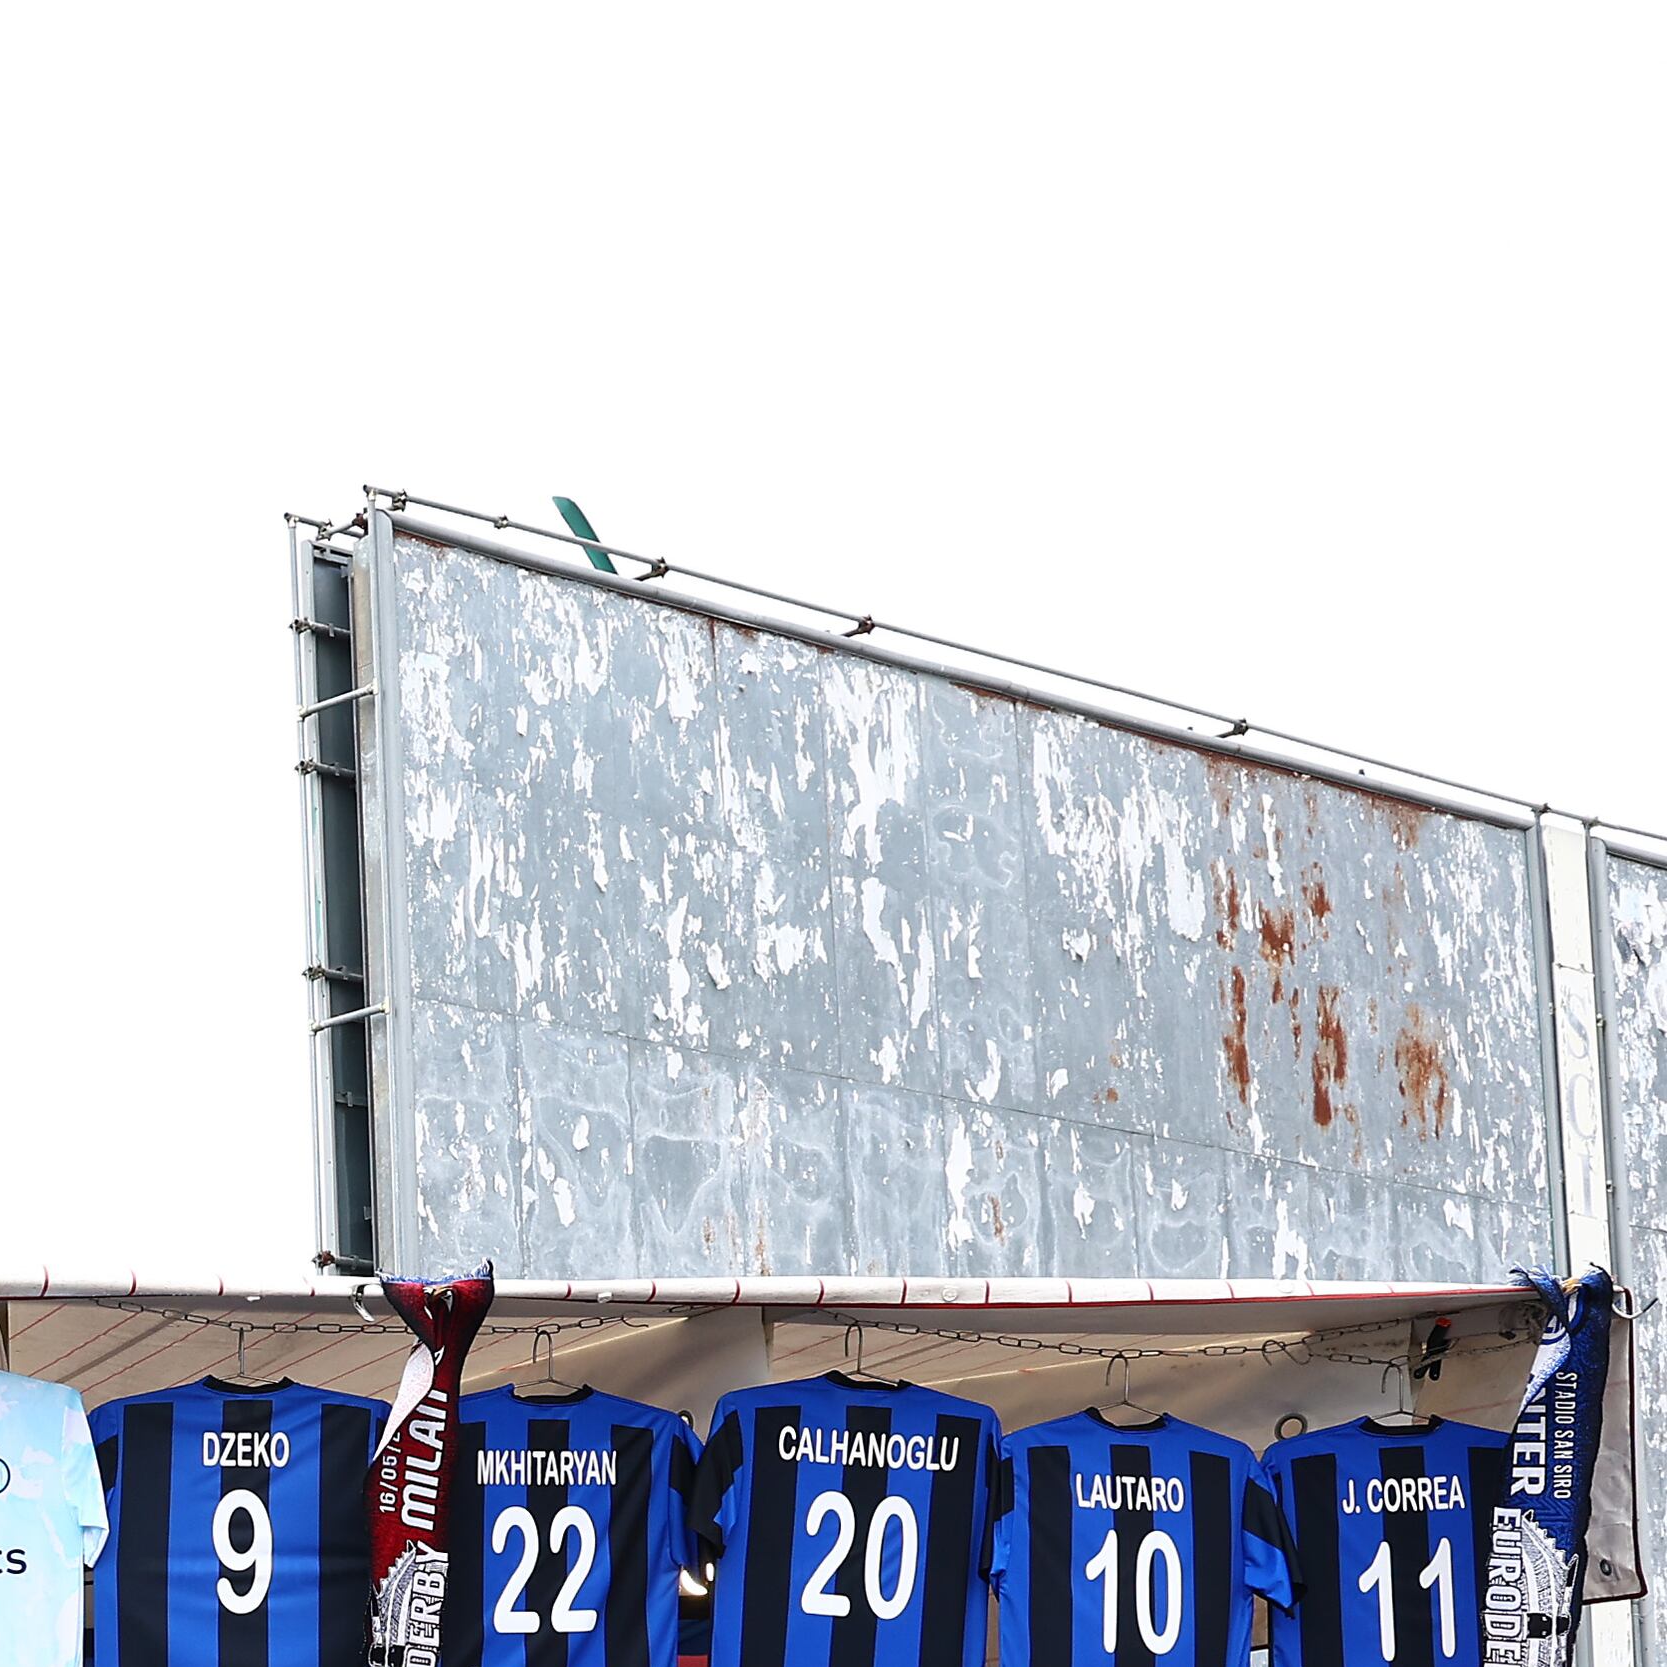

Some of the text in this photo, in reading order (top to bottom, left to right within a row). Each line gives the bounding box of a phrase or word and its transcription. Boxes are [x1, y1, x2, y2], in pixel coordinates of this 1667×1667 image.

[202, 1431, 289, 1467] DZEKO
[477, 1450, 616, 1487] MKHITARYAN
[779, 1425, 959, 1471] CALHANOGLU
[1076, 1473, 1185, 1512] LAUTARO
[1342, 1476, 1465, 1514] J. CORREA
[212, 1489, 275, 1614] 9
[492, 1504, 597, 1634] 22
[801, 1490, 919, 1620] 20
[1085, 1530, 1182, 1656] 10
[1358, 1537, 1455, 1661] 11
